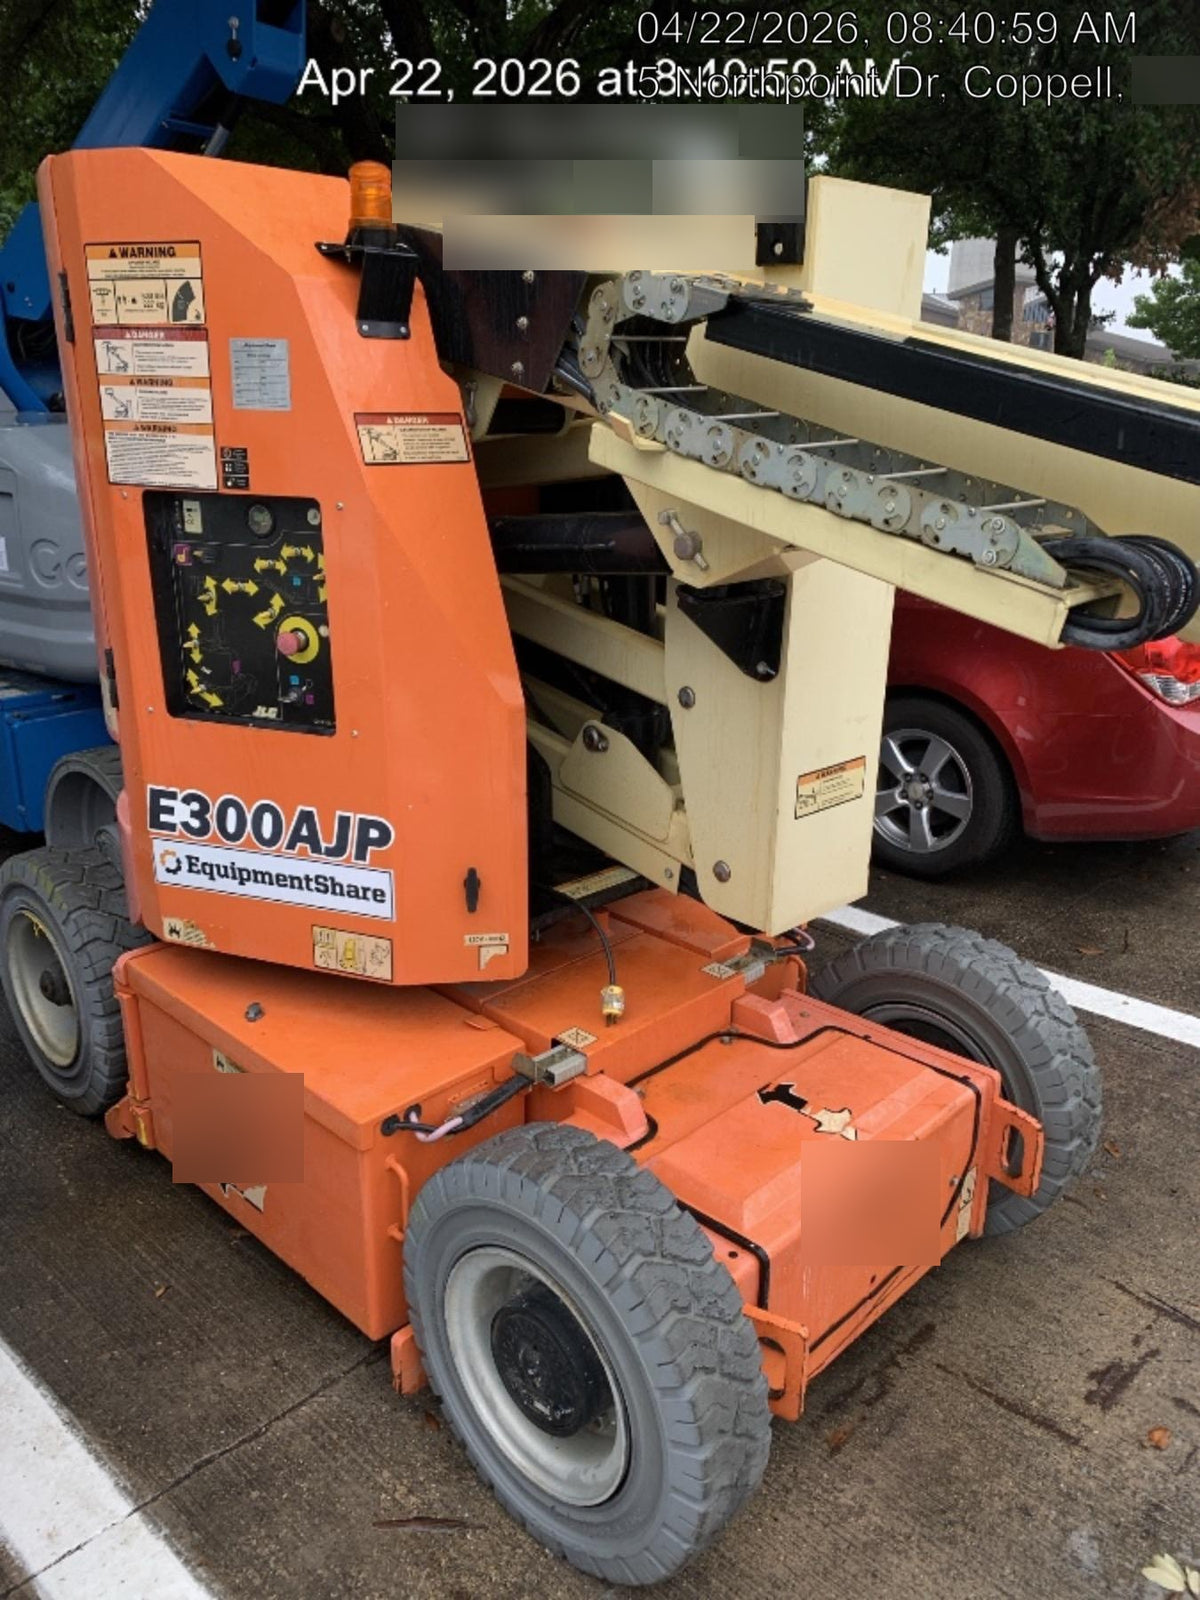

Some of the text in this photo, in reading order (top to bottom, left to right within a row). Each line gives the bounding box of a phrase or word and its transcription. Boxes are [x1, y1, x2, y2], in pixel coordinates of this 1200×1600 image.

[120, 246, 176, 259] WARNING
[148, 785, 395, 864] E300AJP
[185, 855, 386, 904] EquipmentShare
